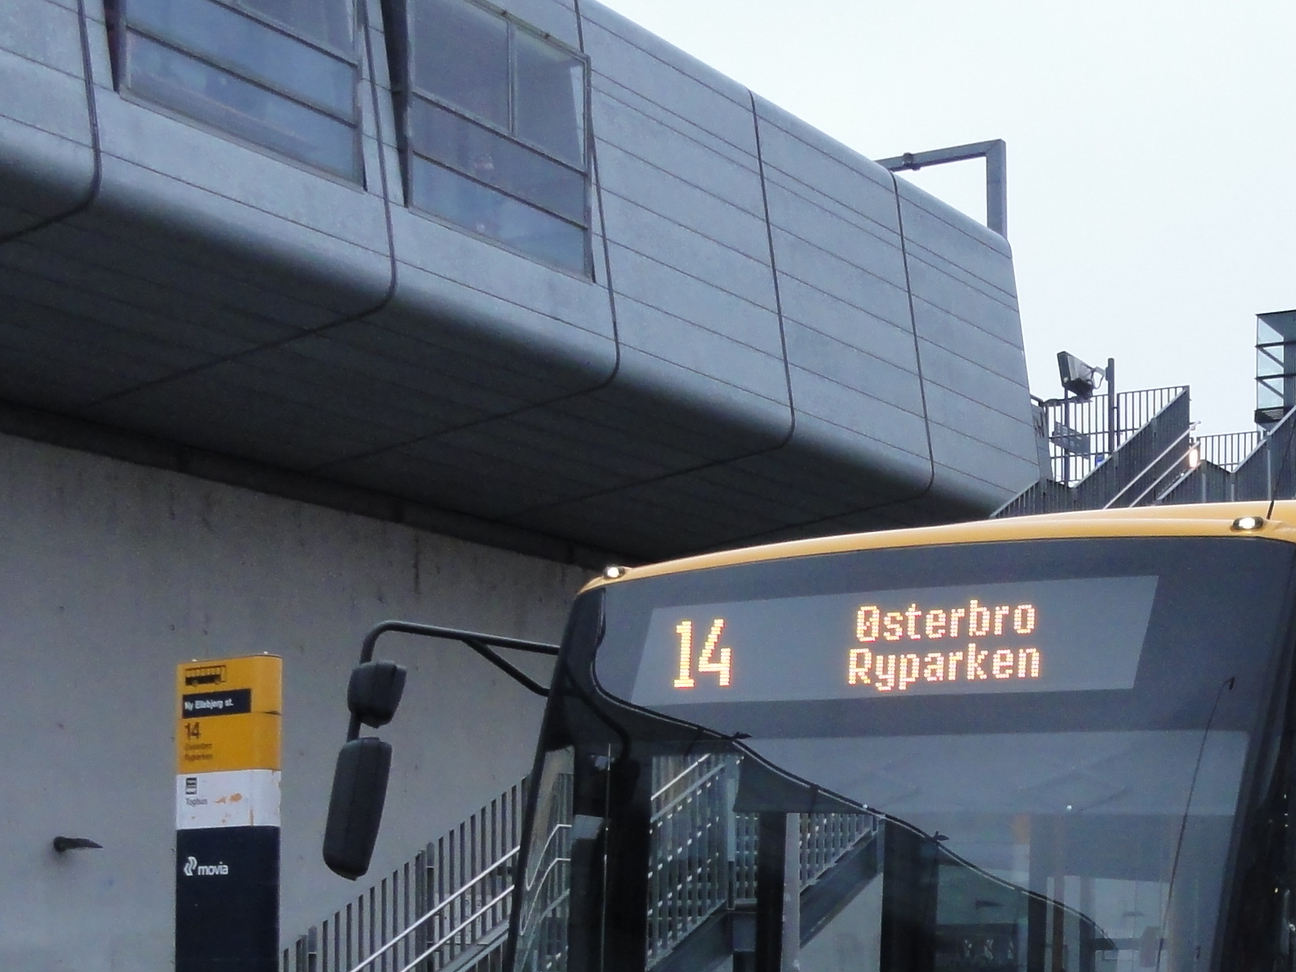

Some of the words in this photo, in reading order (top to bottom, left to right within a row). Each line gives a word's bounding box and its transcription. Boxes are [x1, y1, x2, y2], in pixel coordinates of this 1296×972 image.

[856, 600, 1036, 642] Østerbro
[674, 619, 732, 688] 14
[848, 643, 1040, 691] Ryparken
[185, 722, 201, 740] 14
[197, 861, 229, 876] movia
